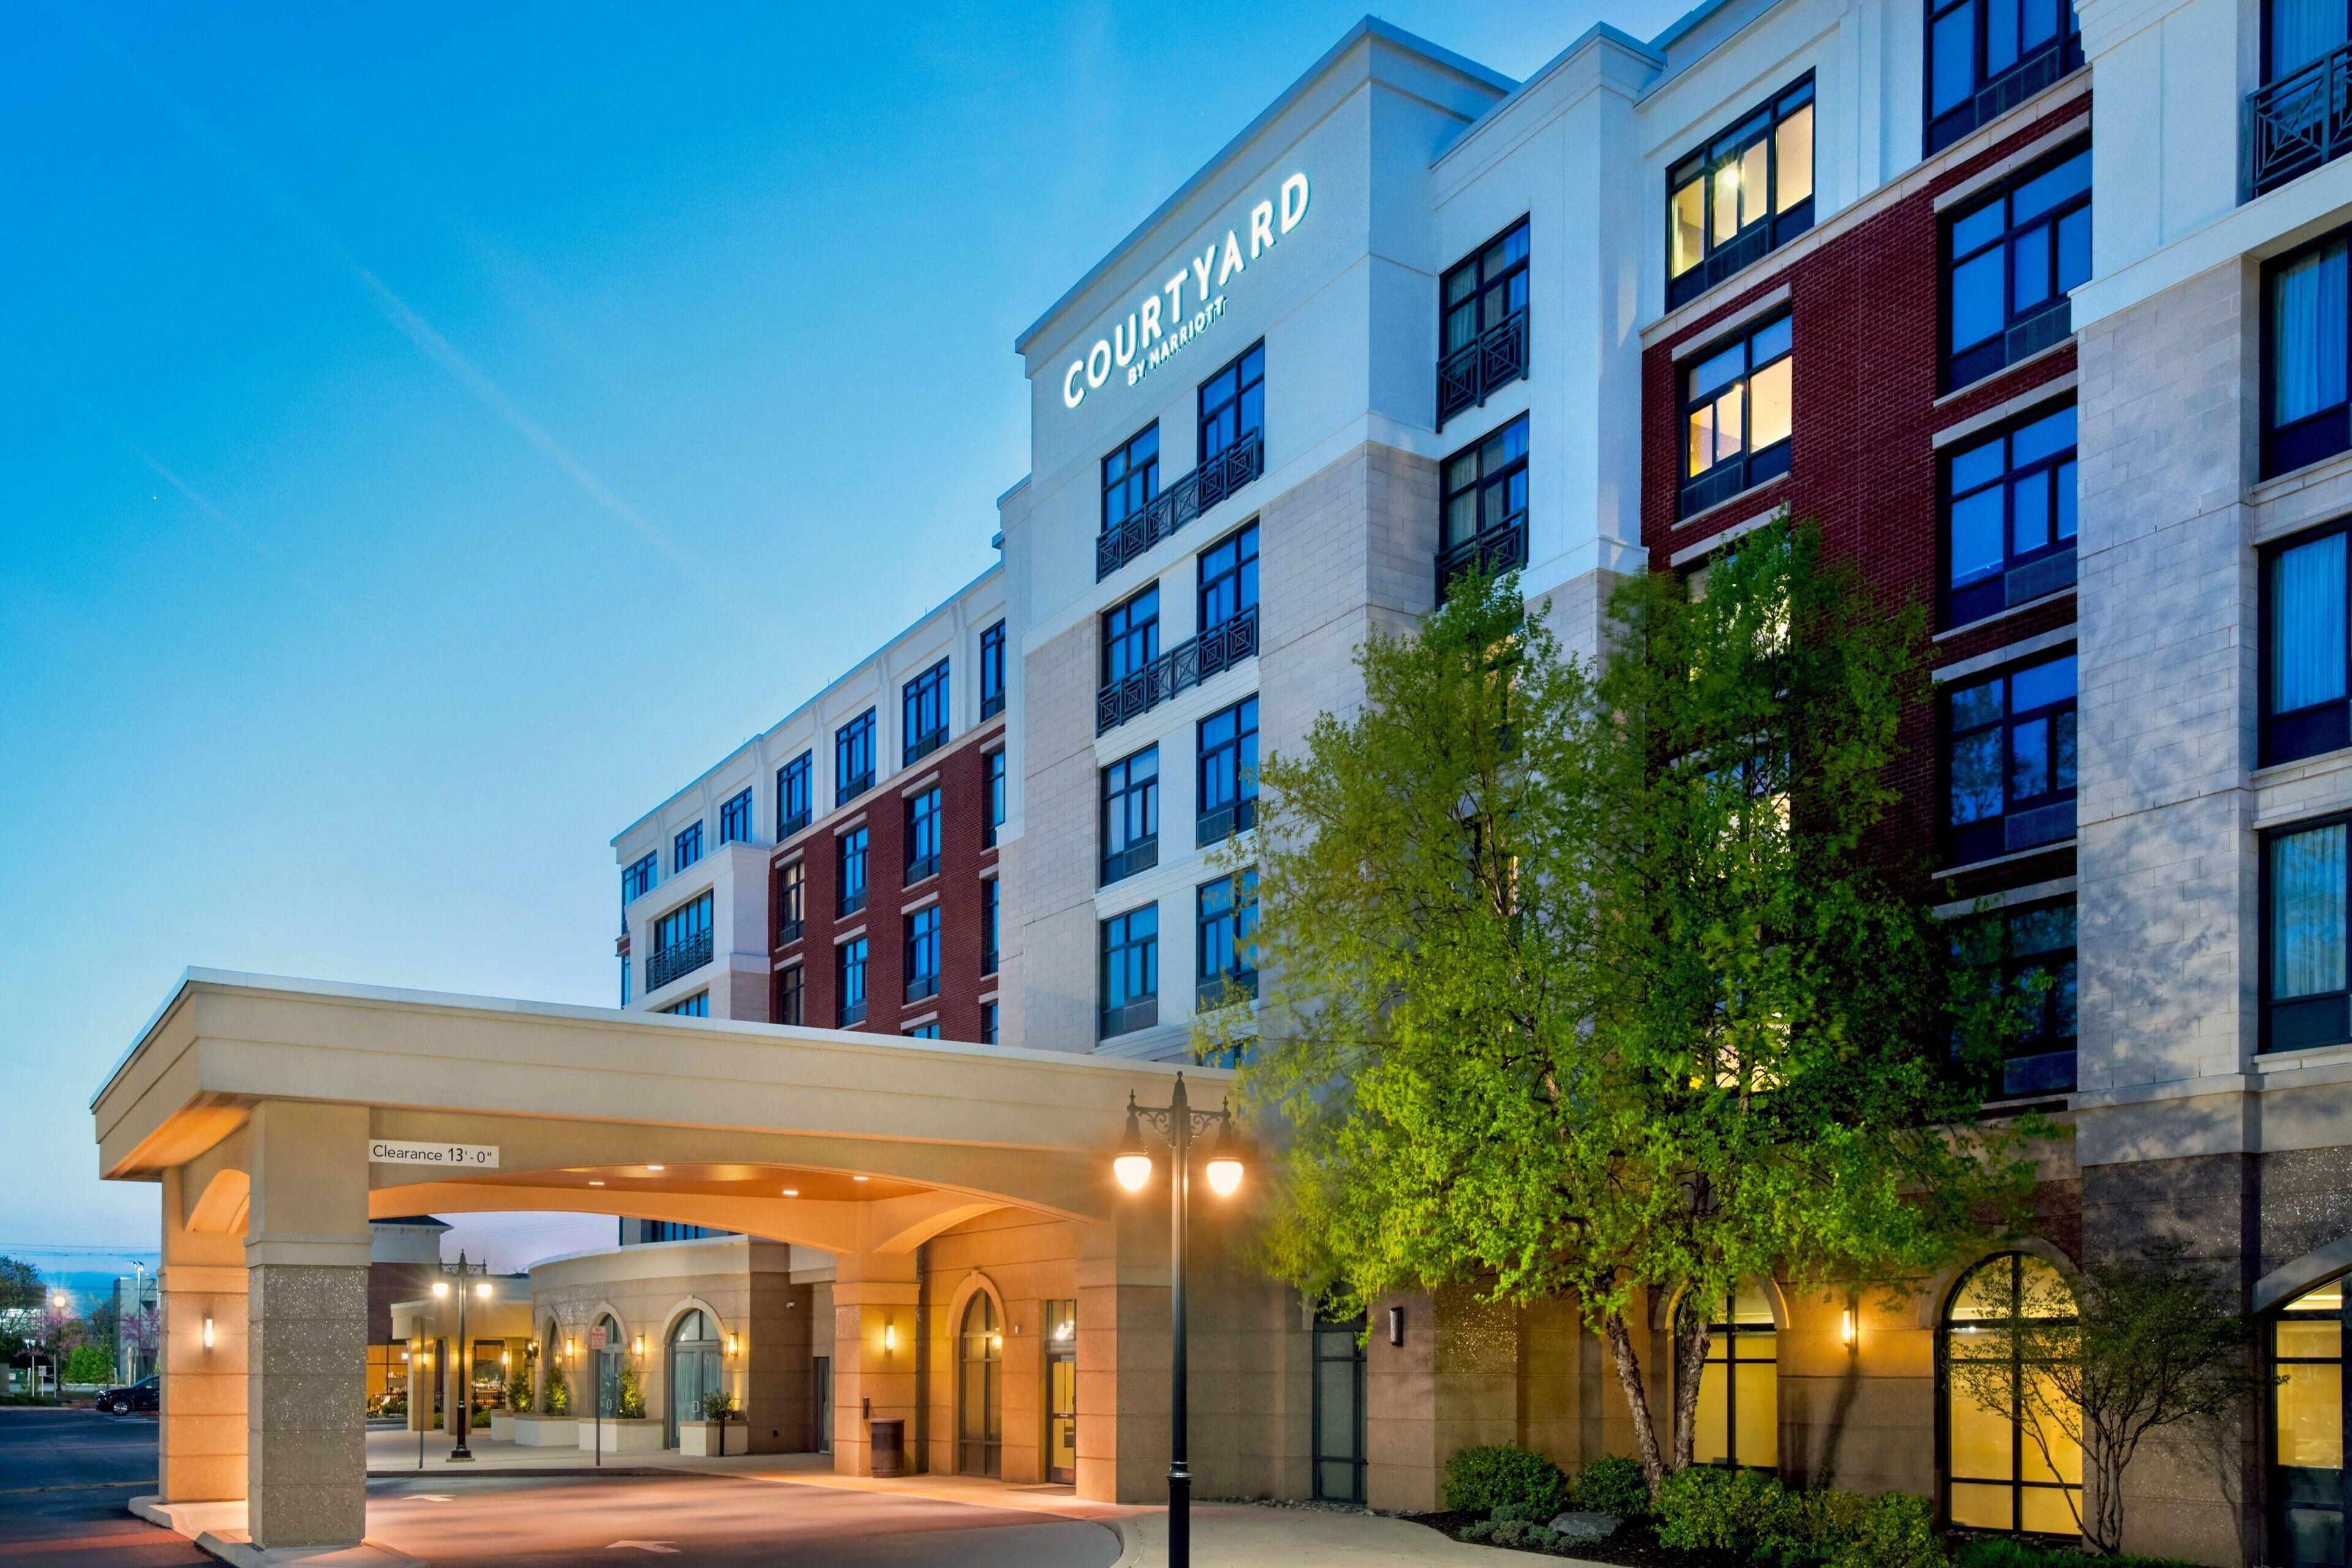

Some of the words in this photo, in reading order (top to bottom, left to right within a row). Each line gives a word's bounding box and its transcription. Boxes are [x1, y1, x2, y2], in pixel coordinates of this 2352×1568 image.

[1064, 173, 1310, 408] COURTYARD
[1128, 359, 1148, 386] BY
[1150, 295, 1226, 370] MARRIOTT
[372, 1144, 442, 1161] Clearance
